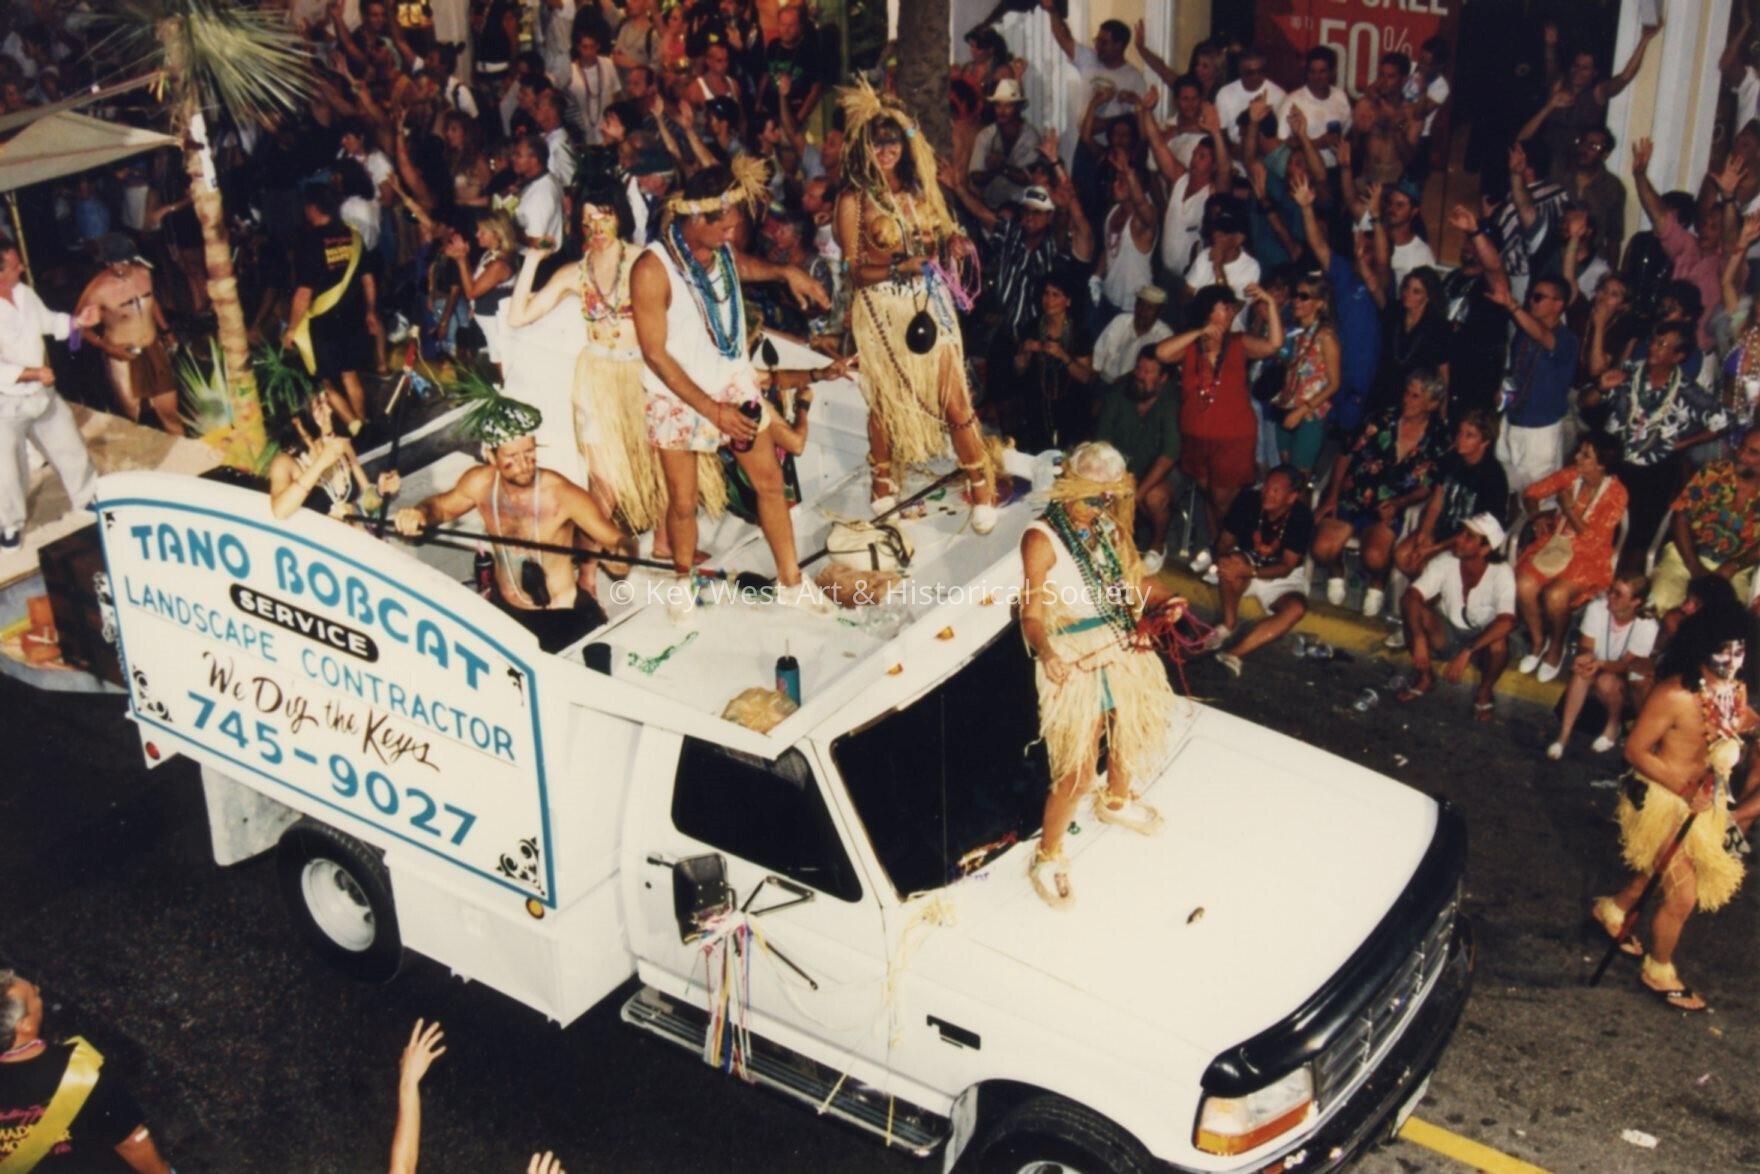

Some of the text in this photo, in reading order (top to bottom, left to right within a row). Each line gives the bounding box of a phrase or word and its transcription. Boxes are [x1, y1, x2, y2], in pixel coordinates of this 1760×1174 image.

[1318, 18, 1413, 99] 50%
[124, 574, 515, 761] LANDSCAPE CONTRACTOR
[130, 523, 490, 691] TANO BOBCAT
[238, 589, 369, 657] SERVICE
[186, 689, 477, 847] 745-9027
[202, 651, 440, 773] We Dig the Keys
